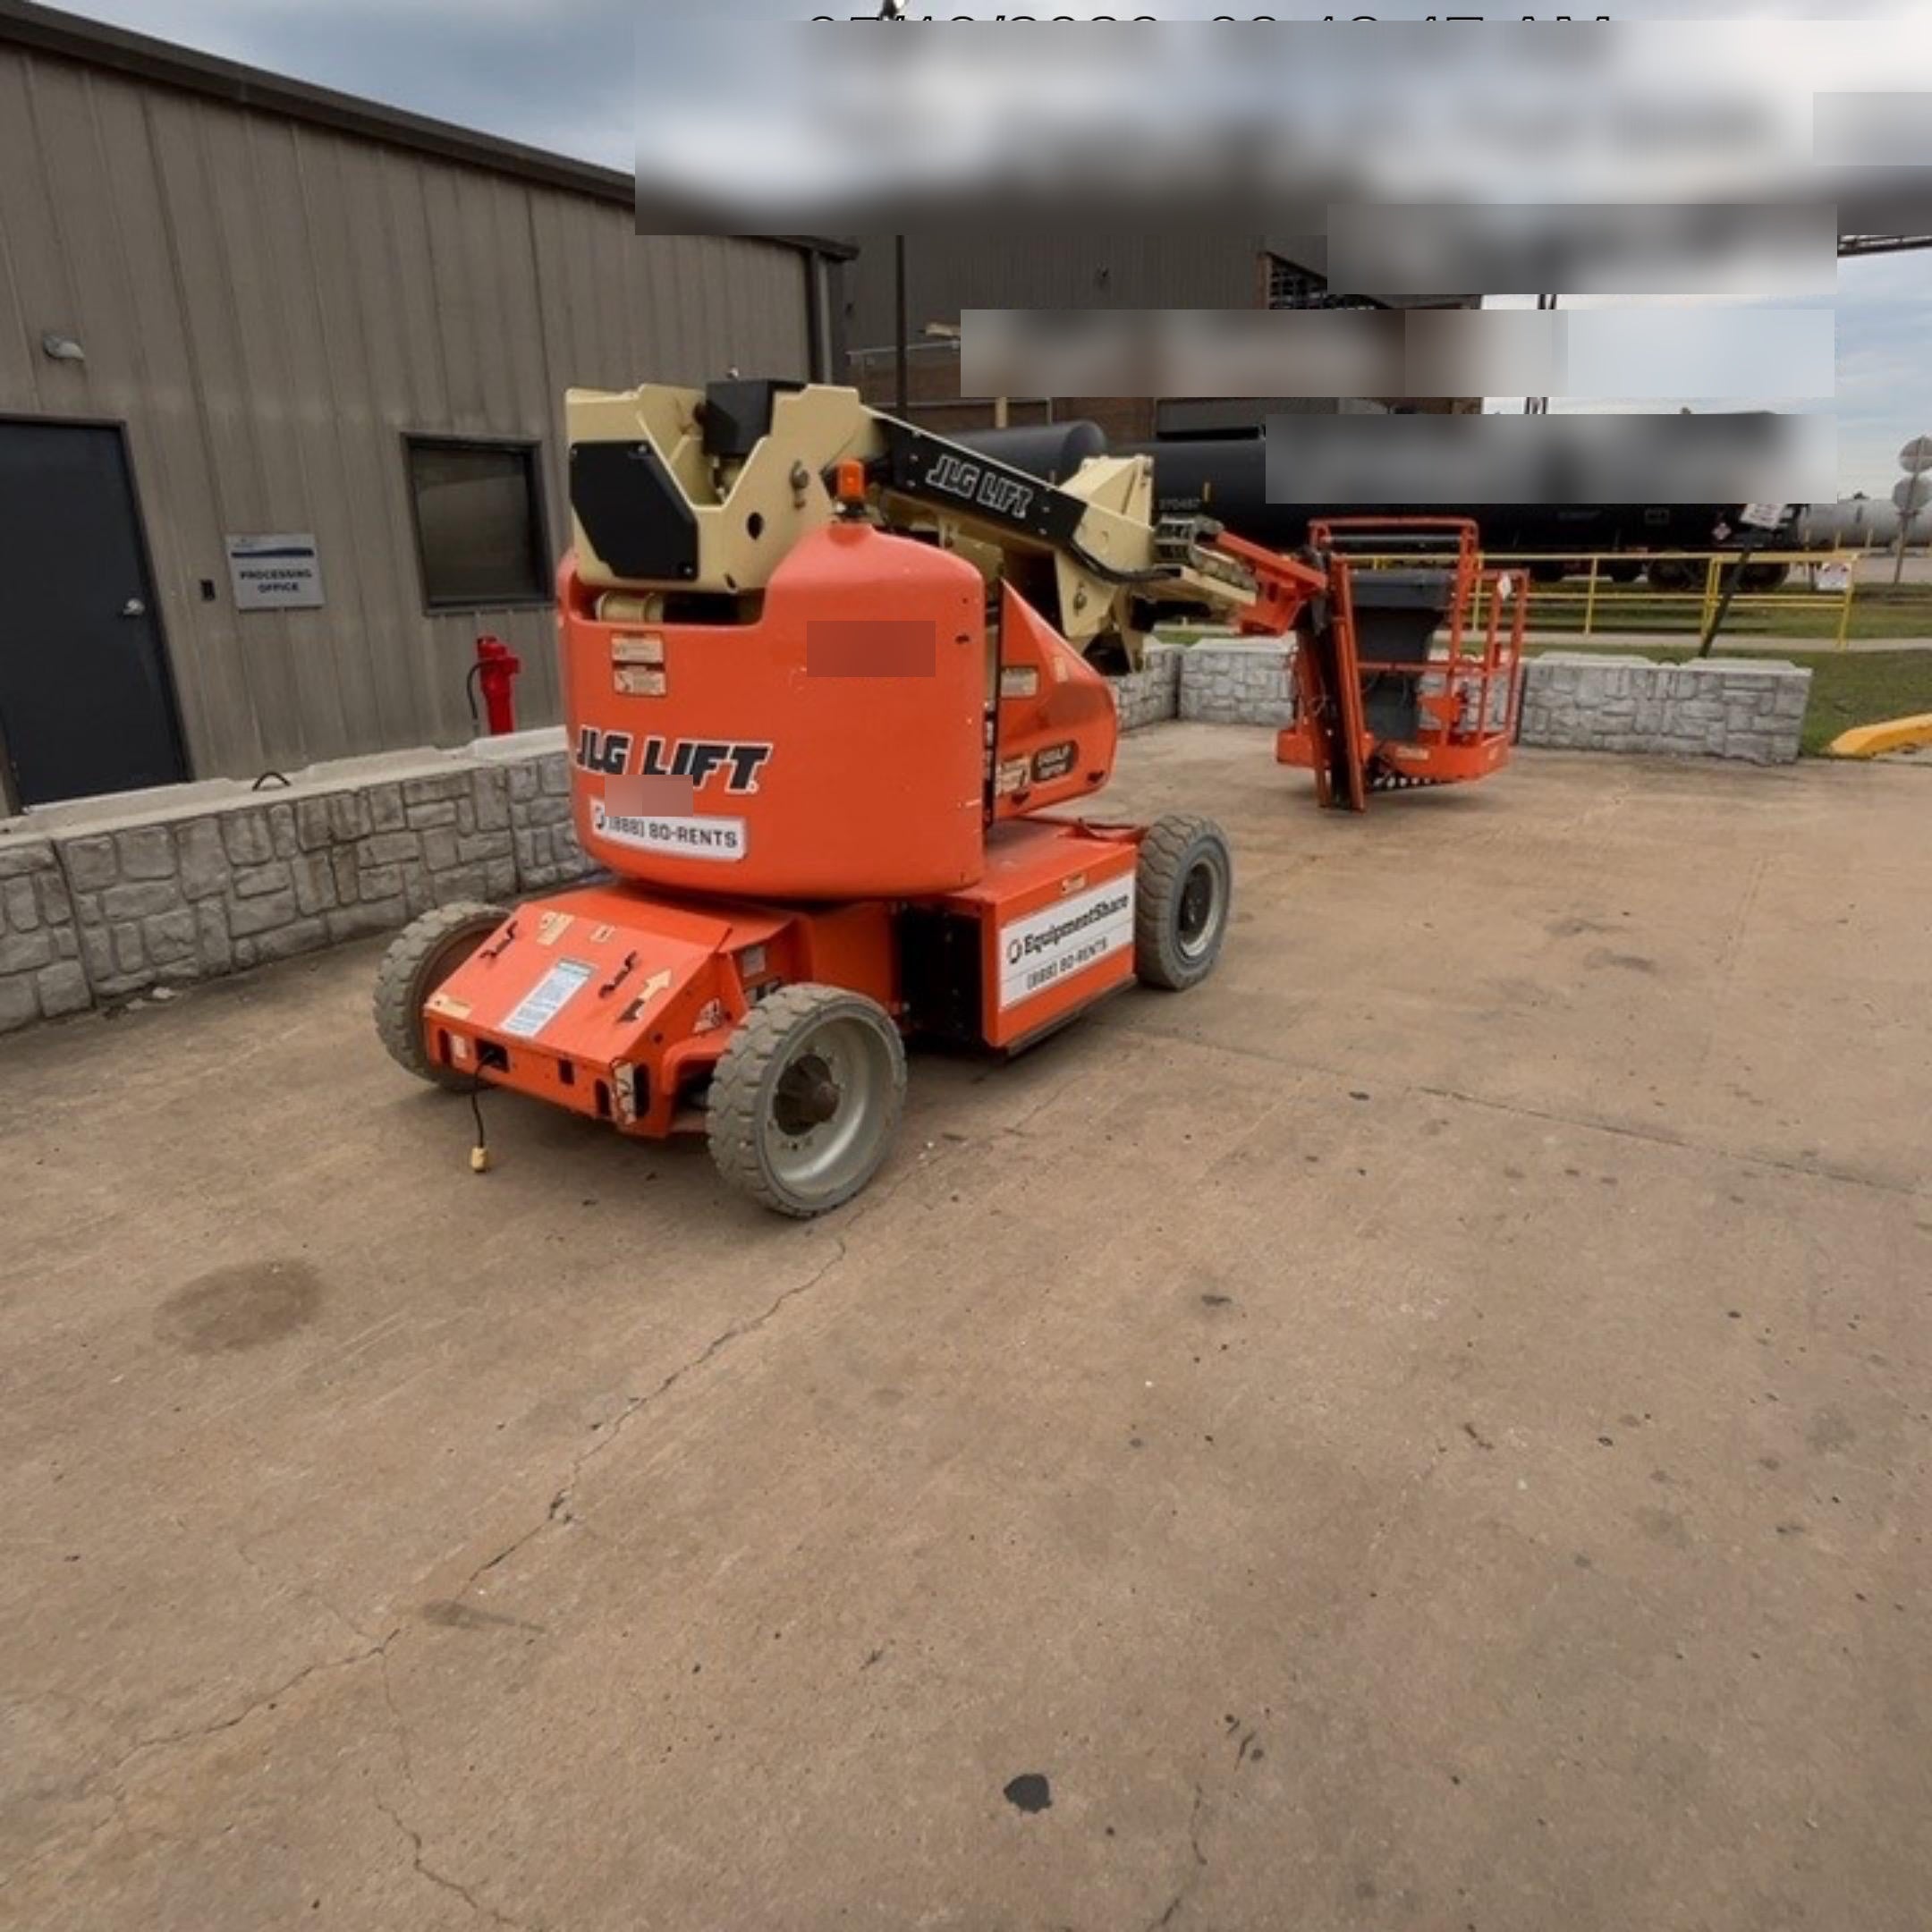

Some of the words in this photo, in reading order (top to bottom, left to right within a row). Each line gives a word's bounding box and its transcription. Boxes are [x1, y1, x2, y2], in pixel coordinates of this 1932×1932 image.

[925, 454, 980, 499] JLG
[976, 471, 1034, 519] LIFT
[239, 569, 312, 580] PROCESSING
[257, 581, 300, 594] OFFICE
[576, 725, 634, 775] JLG
[640, 734, 774, 794] LIFT
[648, 823, 738, 849] 80-RENTS
[1023, 894, 1130, 957] EquipmentShare
